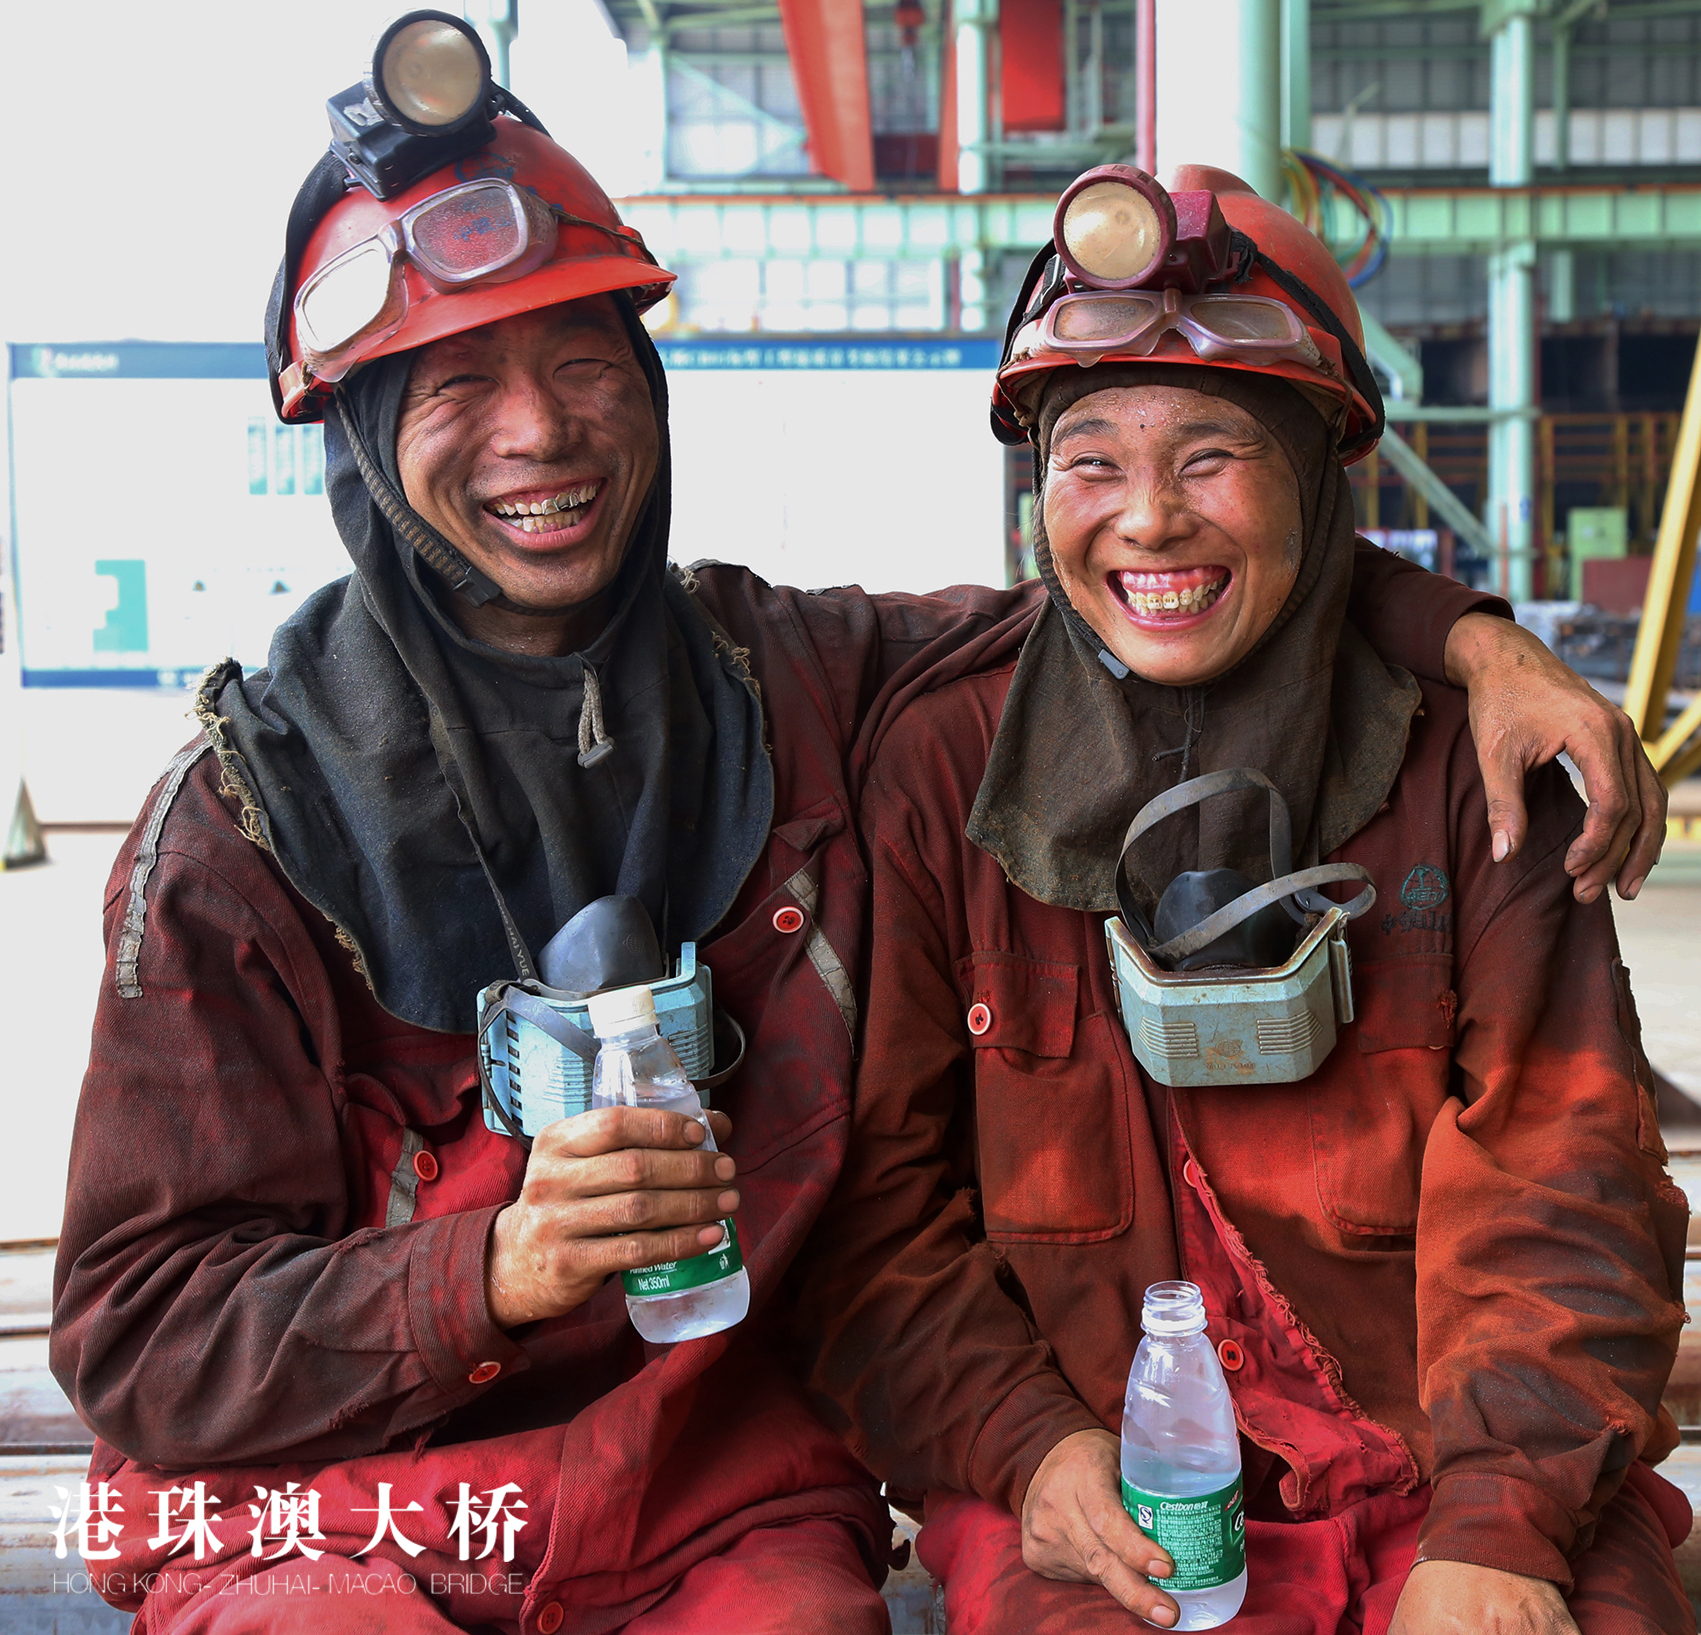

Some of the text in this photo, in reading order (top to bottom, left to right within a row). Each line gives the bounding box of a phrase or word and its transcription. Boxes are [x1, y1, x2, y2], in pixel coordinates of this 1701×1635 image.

[517, 948, 531, 977] YUE
[654, 1260, 677, 1271] Water
[637, 1274, 670, 1291] Net 350ml
